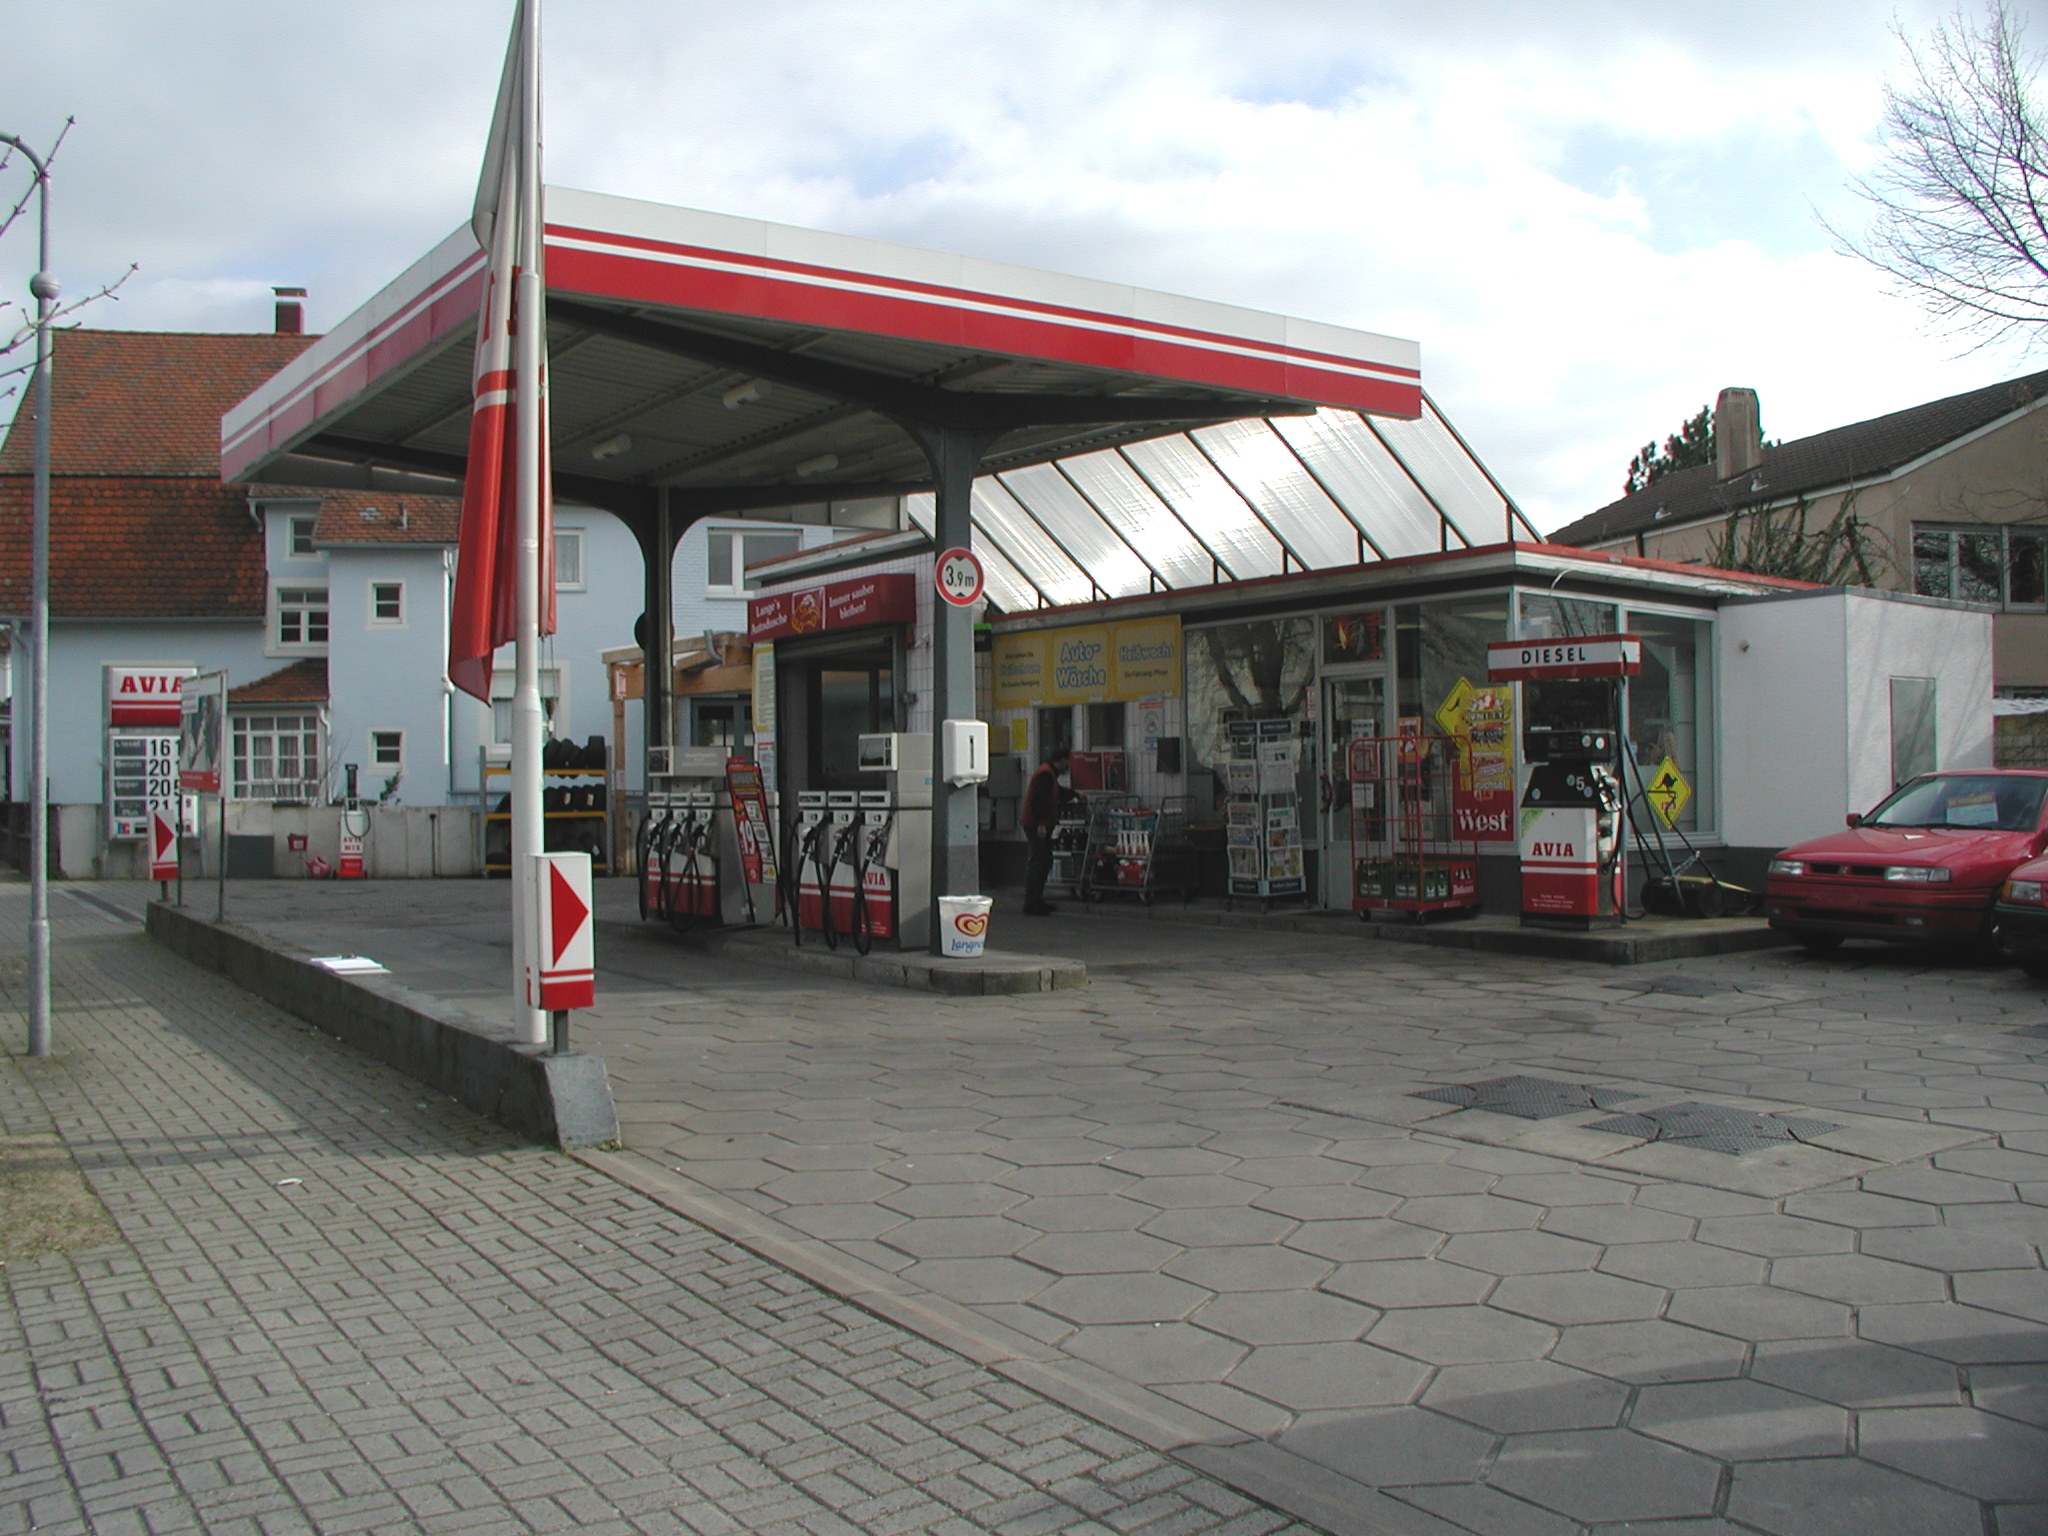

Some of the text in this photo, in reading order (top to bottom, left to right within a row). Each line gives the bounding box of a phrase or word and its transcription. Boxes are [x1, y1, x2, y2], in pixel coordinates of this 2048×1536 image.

[1060, 641, 1102, 664] Auto-
[1521, 647, 1586, 664] DIESEL
[1056, 665, 1107, 689] Wäsche
[1576, 776, 1585, 791] 5
[1456, 808, 1508, 832] West
[1532, 843, 1574, 857] AVIA
